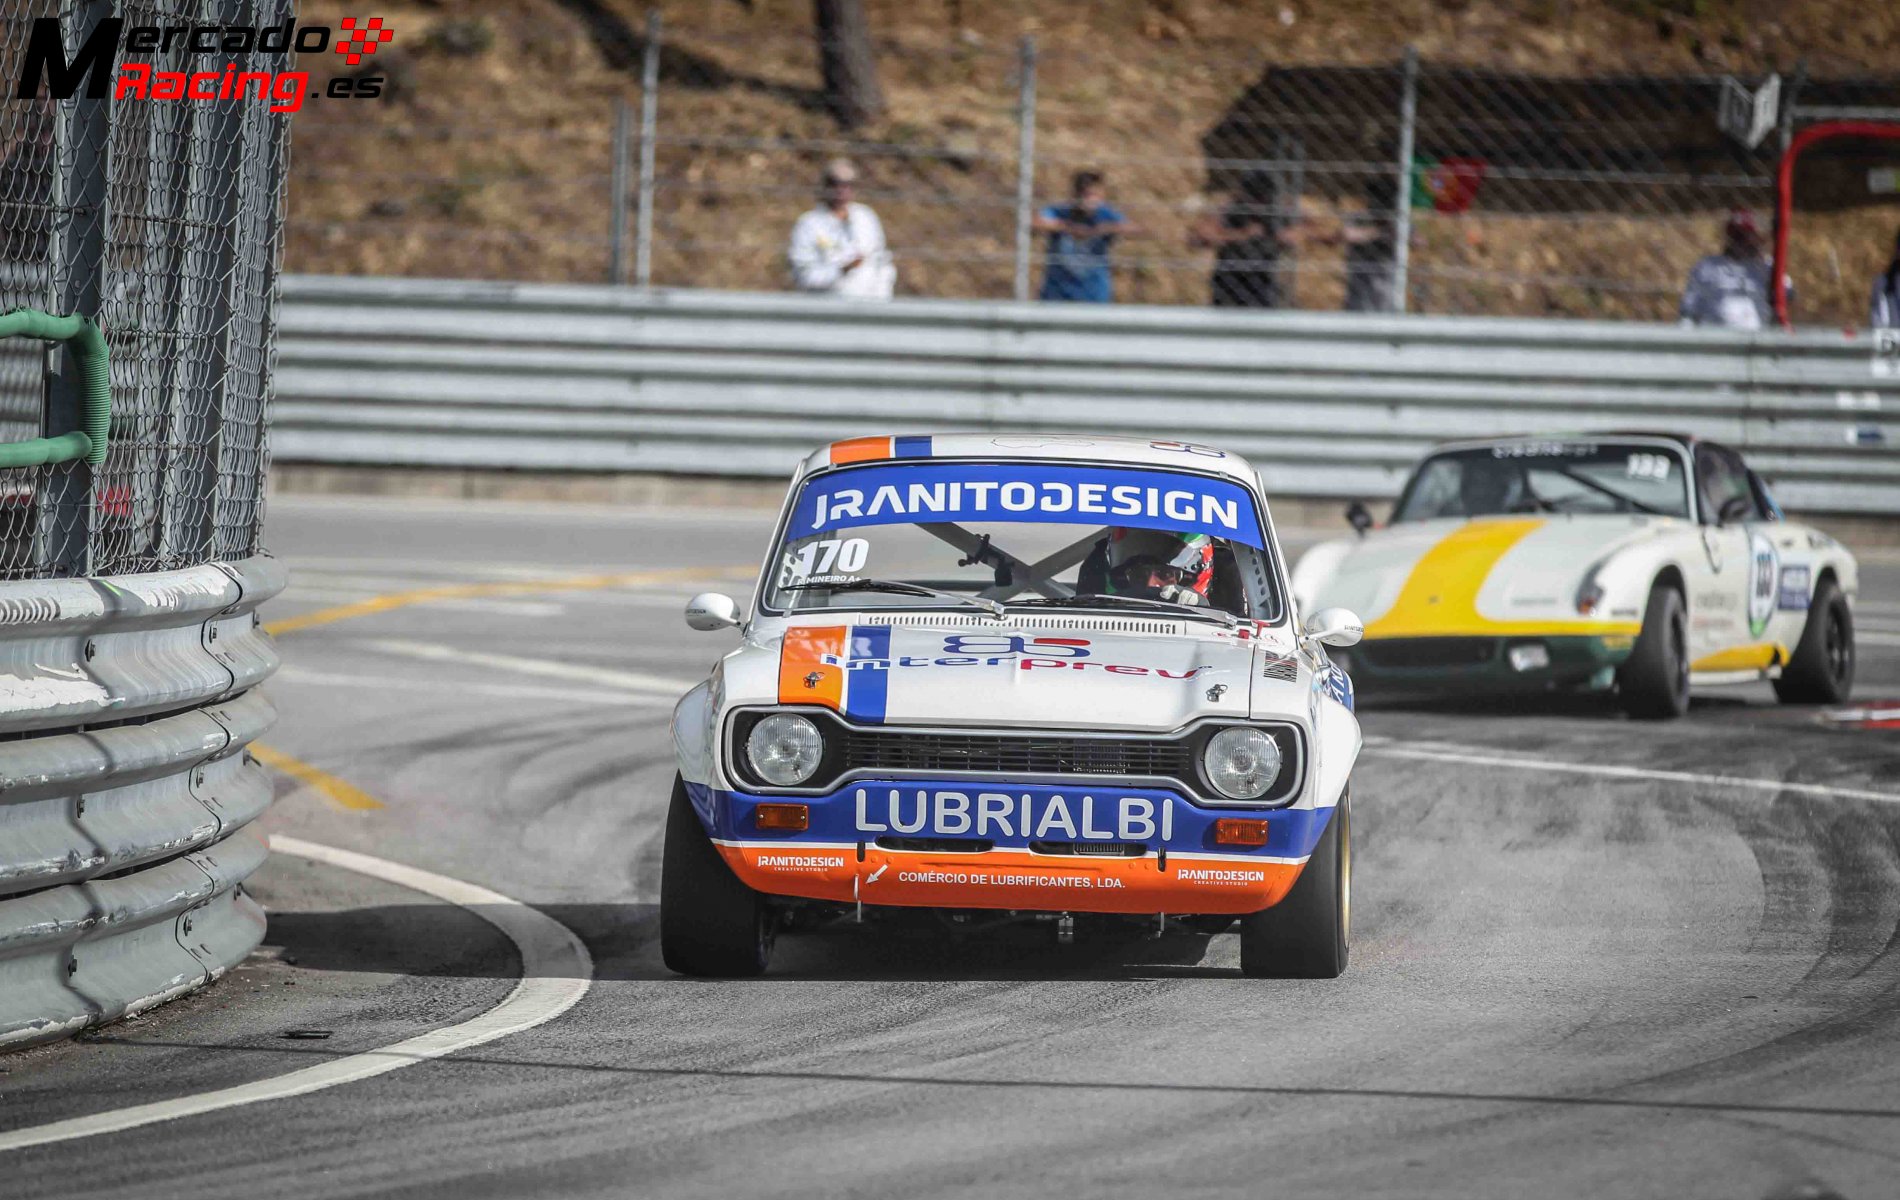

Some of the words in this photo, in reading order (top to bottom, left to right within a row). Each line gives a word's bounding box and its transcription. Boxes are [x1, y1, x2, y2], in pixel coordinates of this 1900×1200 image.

[797, 538, 870, 574] 170
[806, 575, 847, 584] MINEIRO
[855, 788, 1174, 842] LUBRIALBI
[899, 871, 967, 884] COMÉRCIO
[970, 875, 988, 885] DE
[990, 875, 1094, 889] LUBRIFICANTES,
[1097, 877, 1126, 888] LDA.
